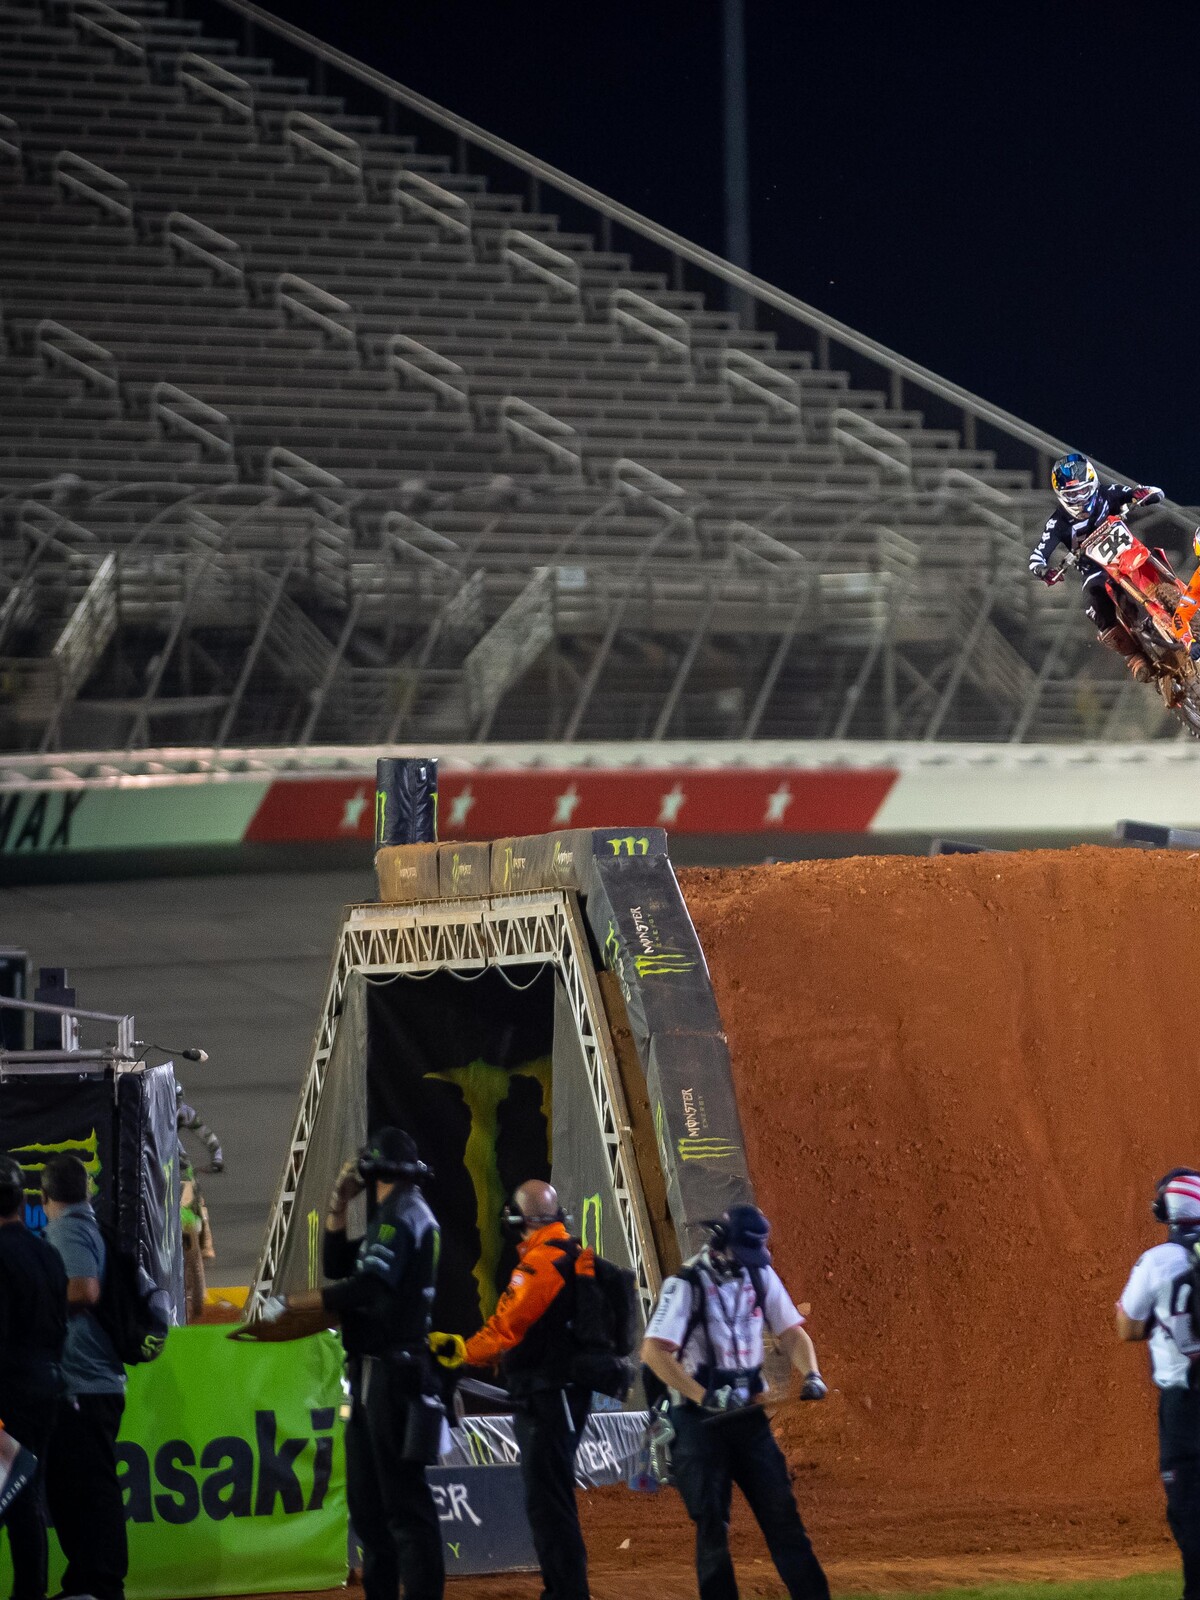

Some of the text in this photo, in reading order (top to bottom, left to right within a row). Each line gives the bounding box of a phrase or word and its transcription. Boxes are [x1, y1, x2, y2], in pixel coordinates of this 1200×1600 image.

[1098, 528, 1132, 564] 94
[630, 906, 654, 955] MONSTER
[681, 1087, 701, 1137] MONSTER
